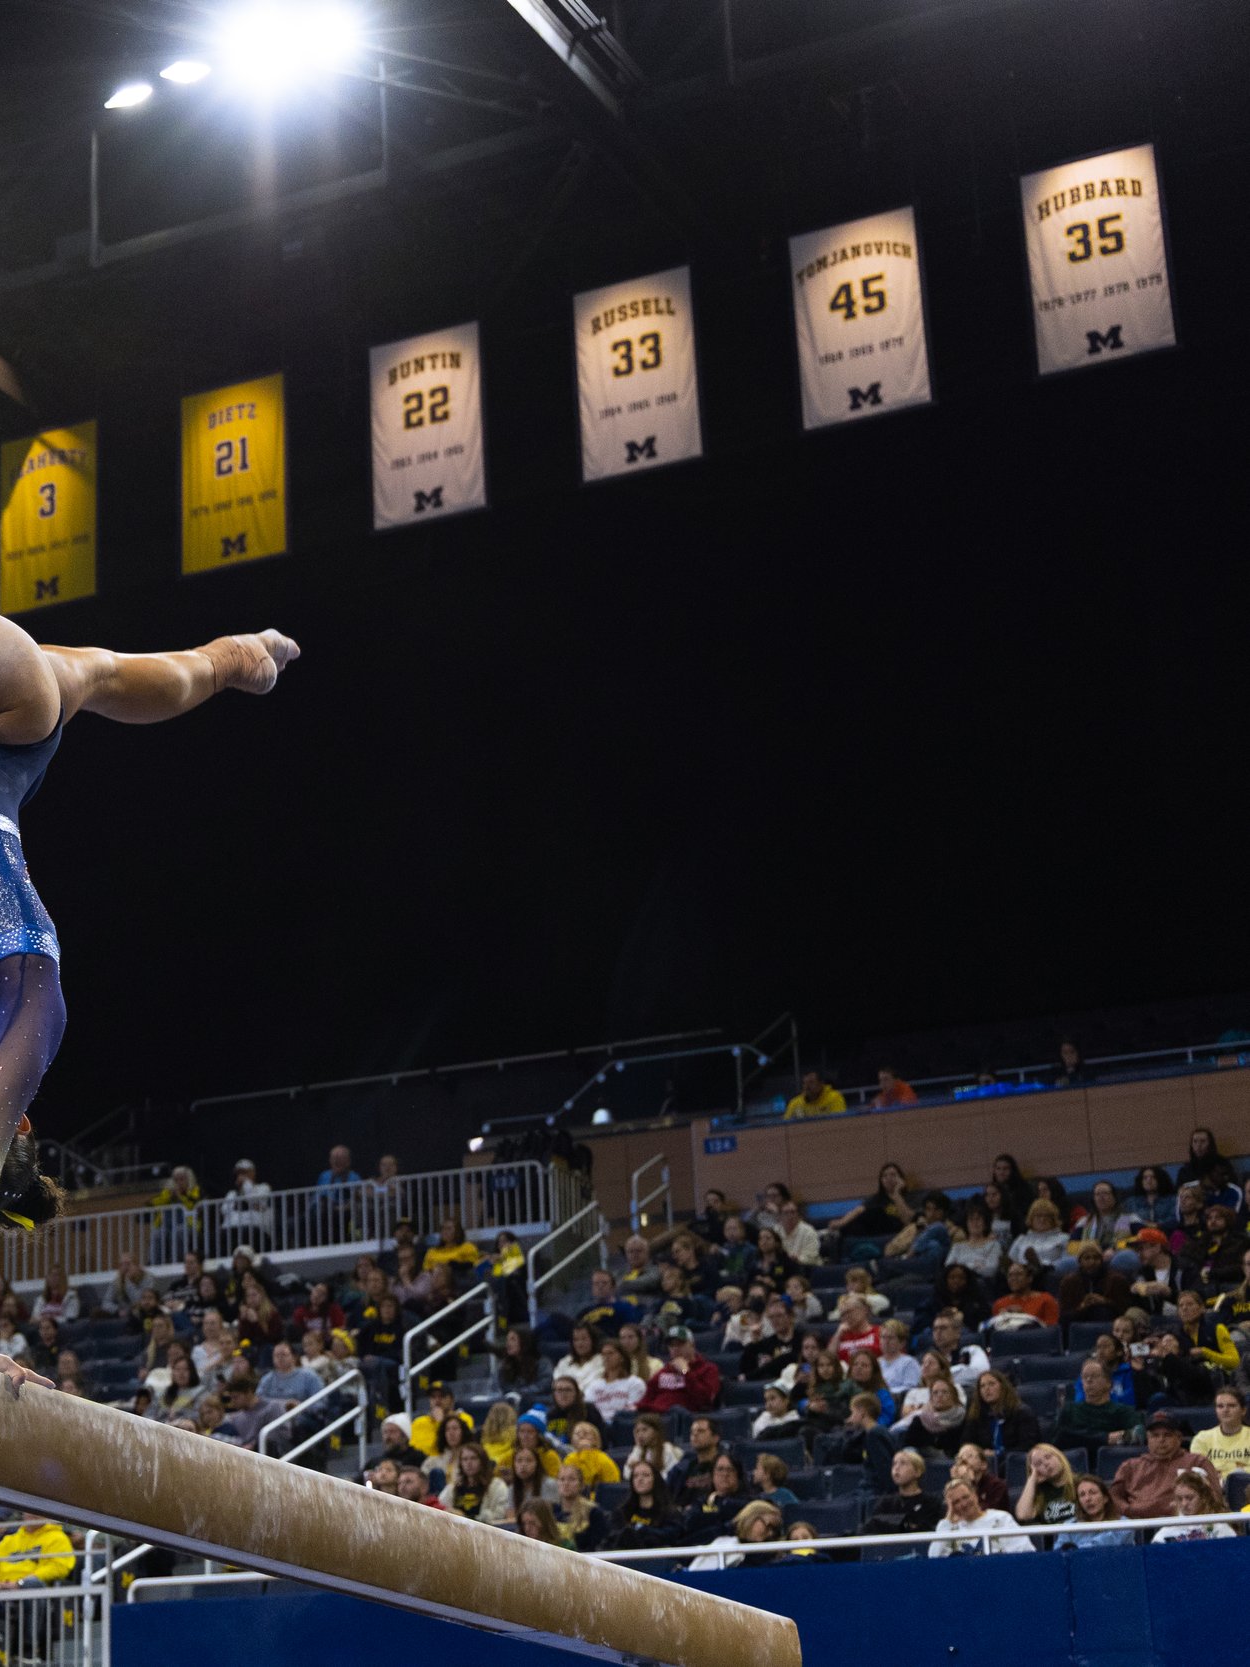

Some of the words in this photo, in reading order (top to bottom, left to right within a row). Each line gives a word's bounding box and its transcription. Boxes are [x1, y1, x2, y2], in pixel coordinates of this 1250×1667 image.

[1037, 178, 1143, 220] HUBBARD
[1065, 213, 1125, 263] 35
[795, 241, 914, 285] TOMJANOVICH
[591, 296, 676, 336] RUSSELL
[829, 272, 888, 322] 45
[611, 331, 663, 377] 33
[1086, 324, 1124, 354] M
[388, 352, 462, 386] BUNTIN
[403, 385, 451, 430] 22
[848, 382, 882, 410] M
[207, 403, 257, 430] DIETZ
[214, 436, 251, 478] 21
[625, 435, 658, 464] M
[39, 482, 56, 520] 3
[414, 486, 444, 513] M
[221, 533, 248, 557] M
[35, 576, 59, 600] M
